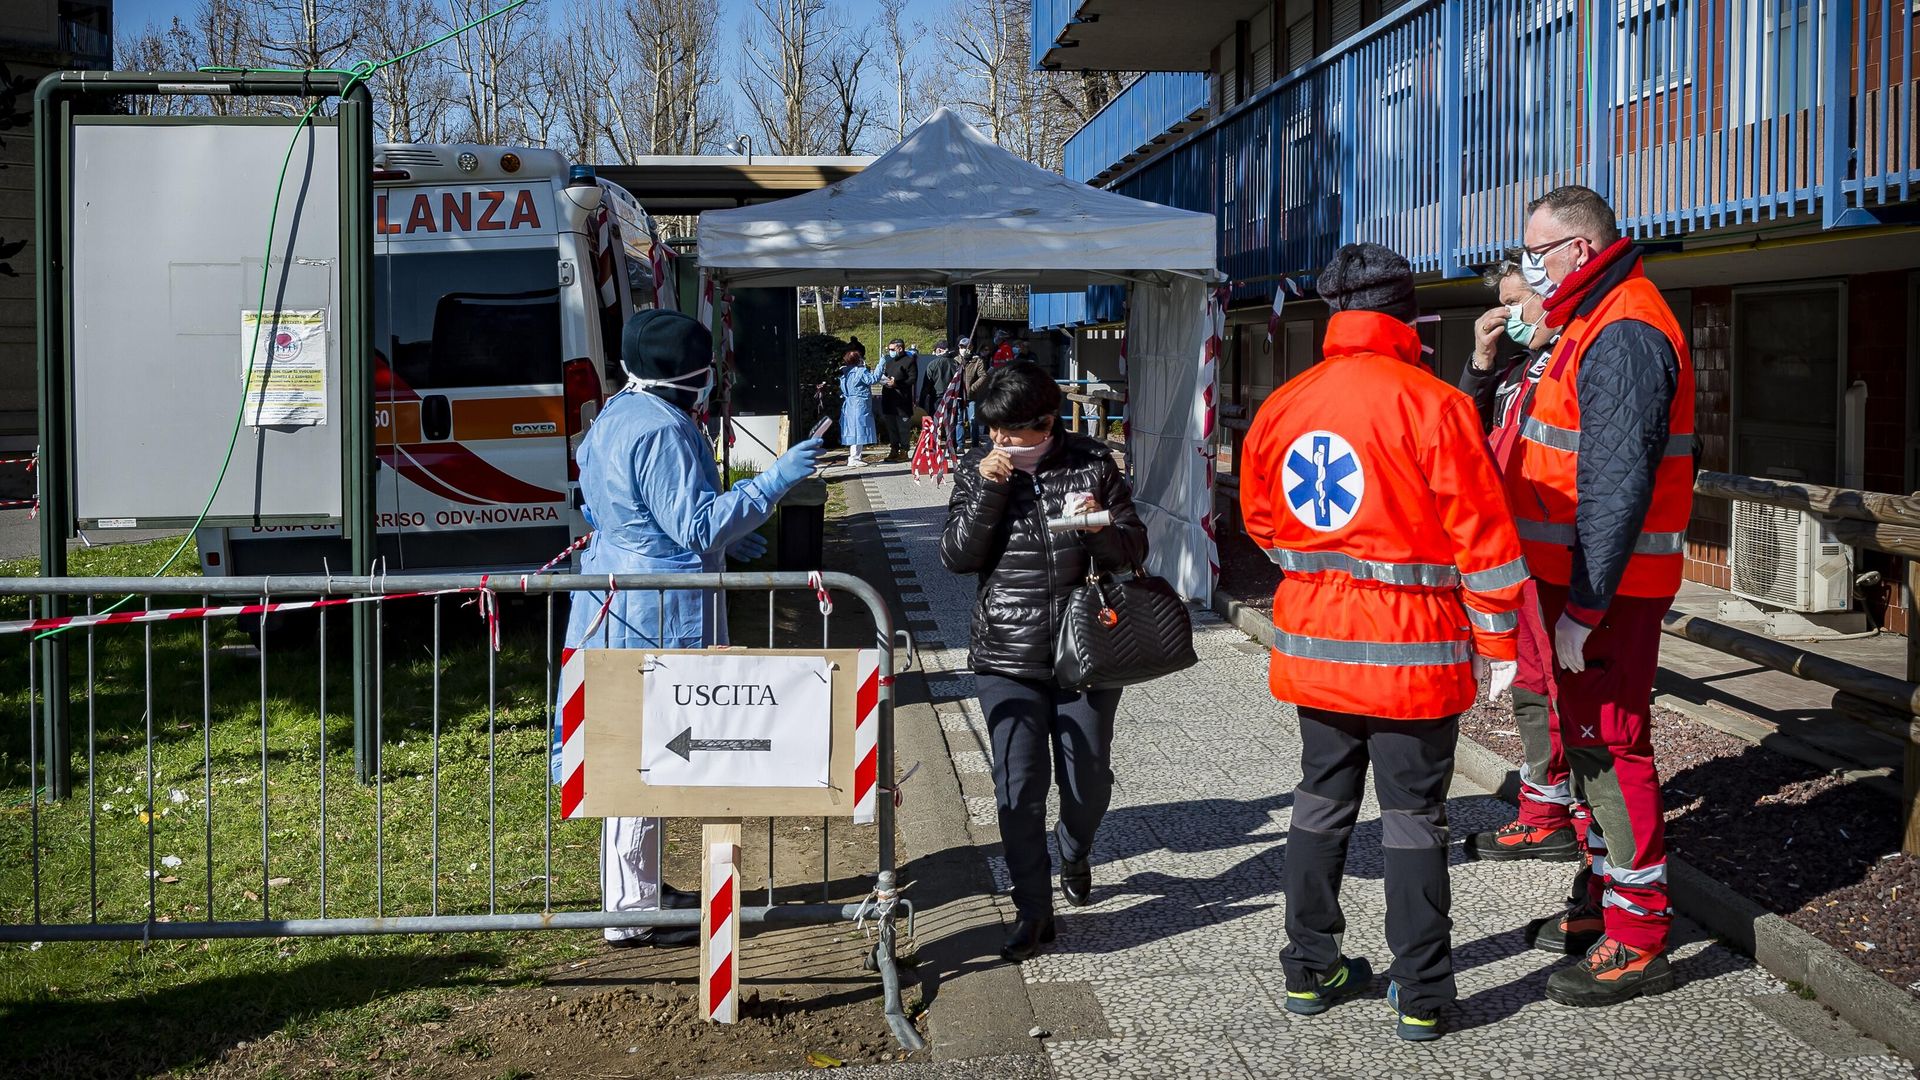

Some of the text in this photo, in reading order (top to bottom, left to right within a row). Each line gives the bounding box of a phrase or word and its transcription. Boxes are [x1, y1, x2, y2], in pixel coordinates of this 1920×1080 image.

[377, 189, 541, 234] LANZA
[436, 506, 559, 525] ODV-NOVARA
[673, 684, 779, 706] USCITA
